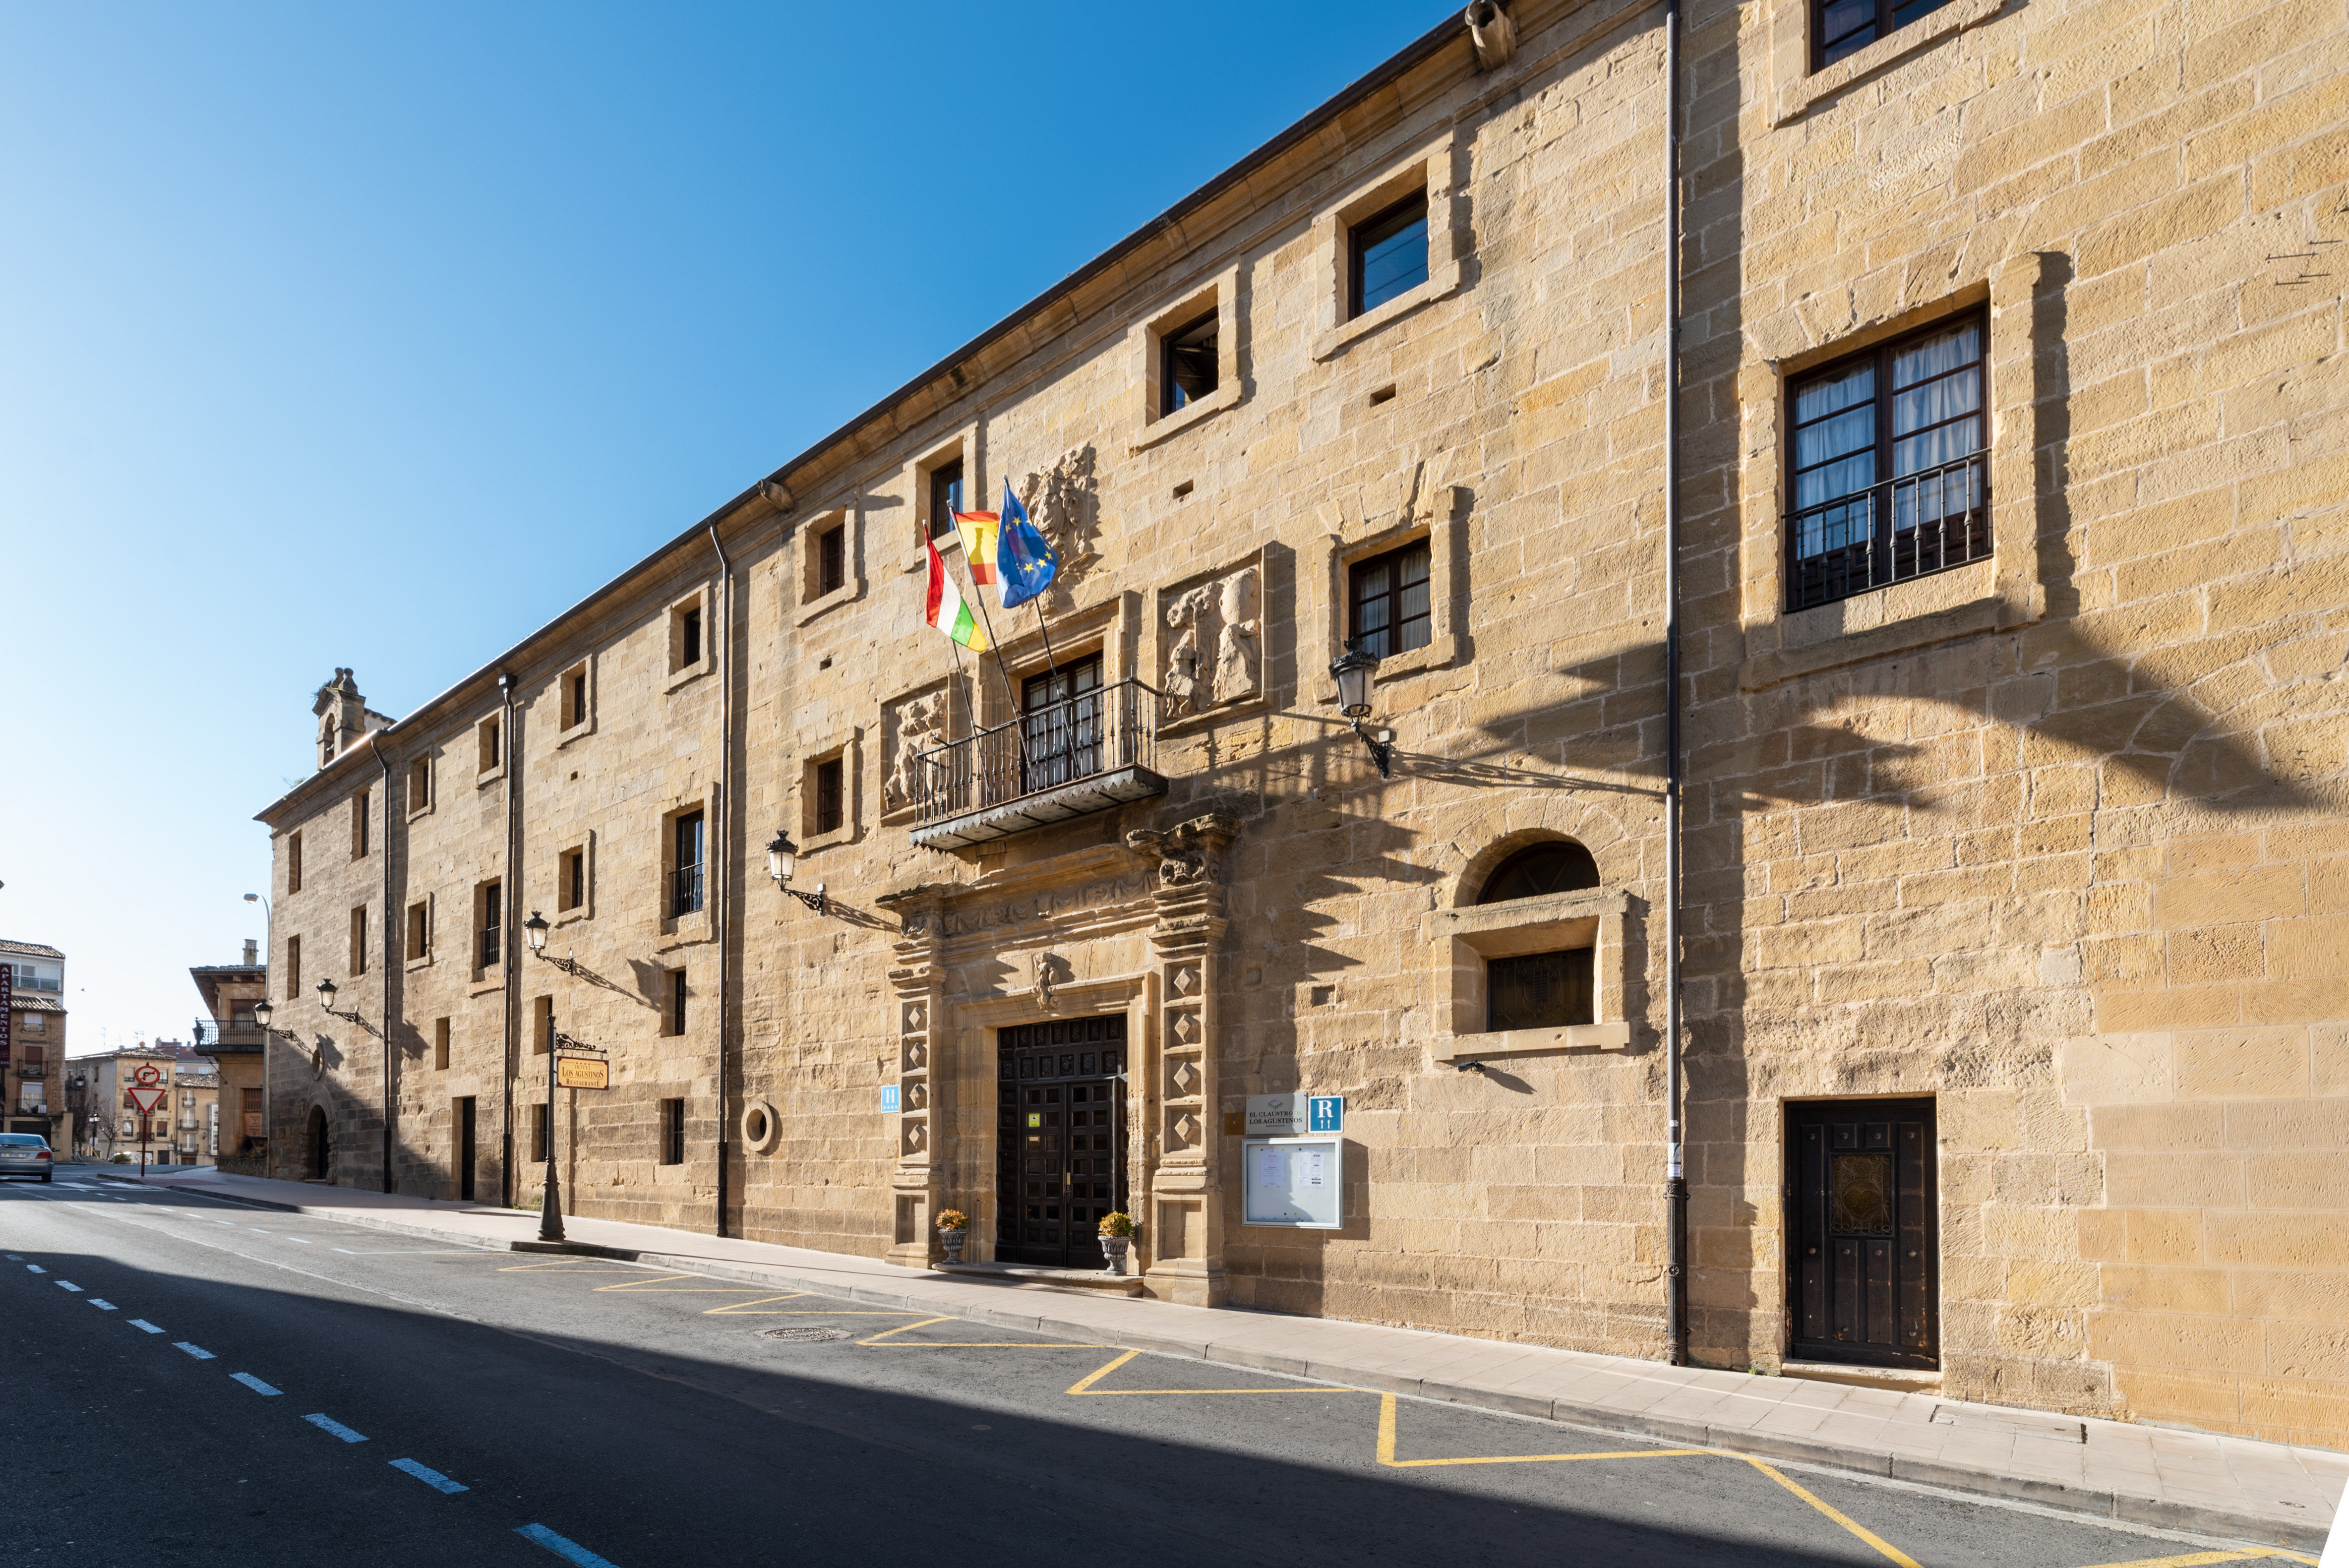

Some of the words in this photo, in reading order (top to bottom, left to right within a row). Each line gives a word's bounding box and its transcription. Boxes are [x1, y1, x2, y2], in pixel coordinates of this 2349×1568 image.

[0, 967, 9, 1045] APARTAMENTOS
[562, 1067, 573, 1077] LOS
[575, 1070, 604, 1079] AGUSTINOS
[566, 1078, 600, 1087] RESTAURANTE
[886, 1089, 895, 1103] H
[1317, 1100, 1334, 1118] R
